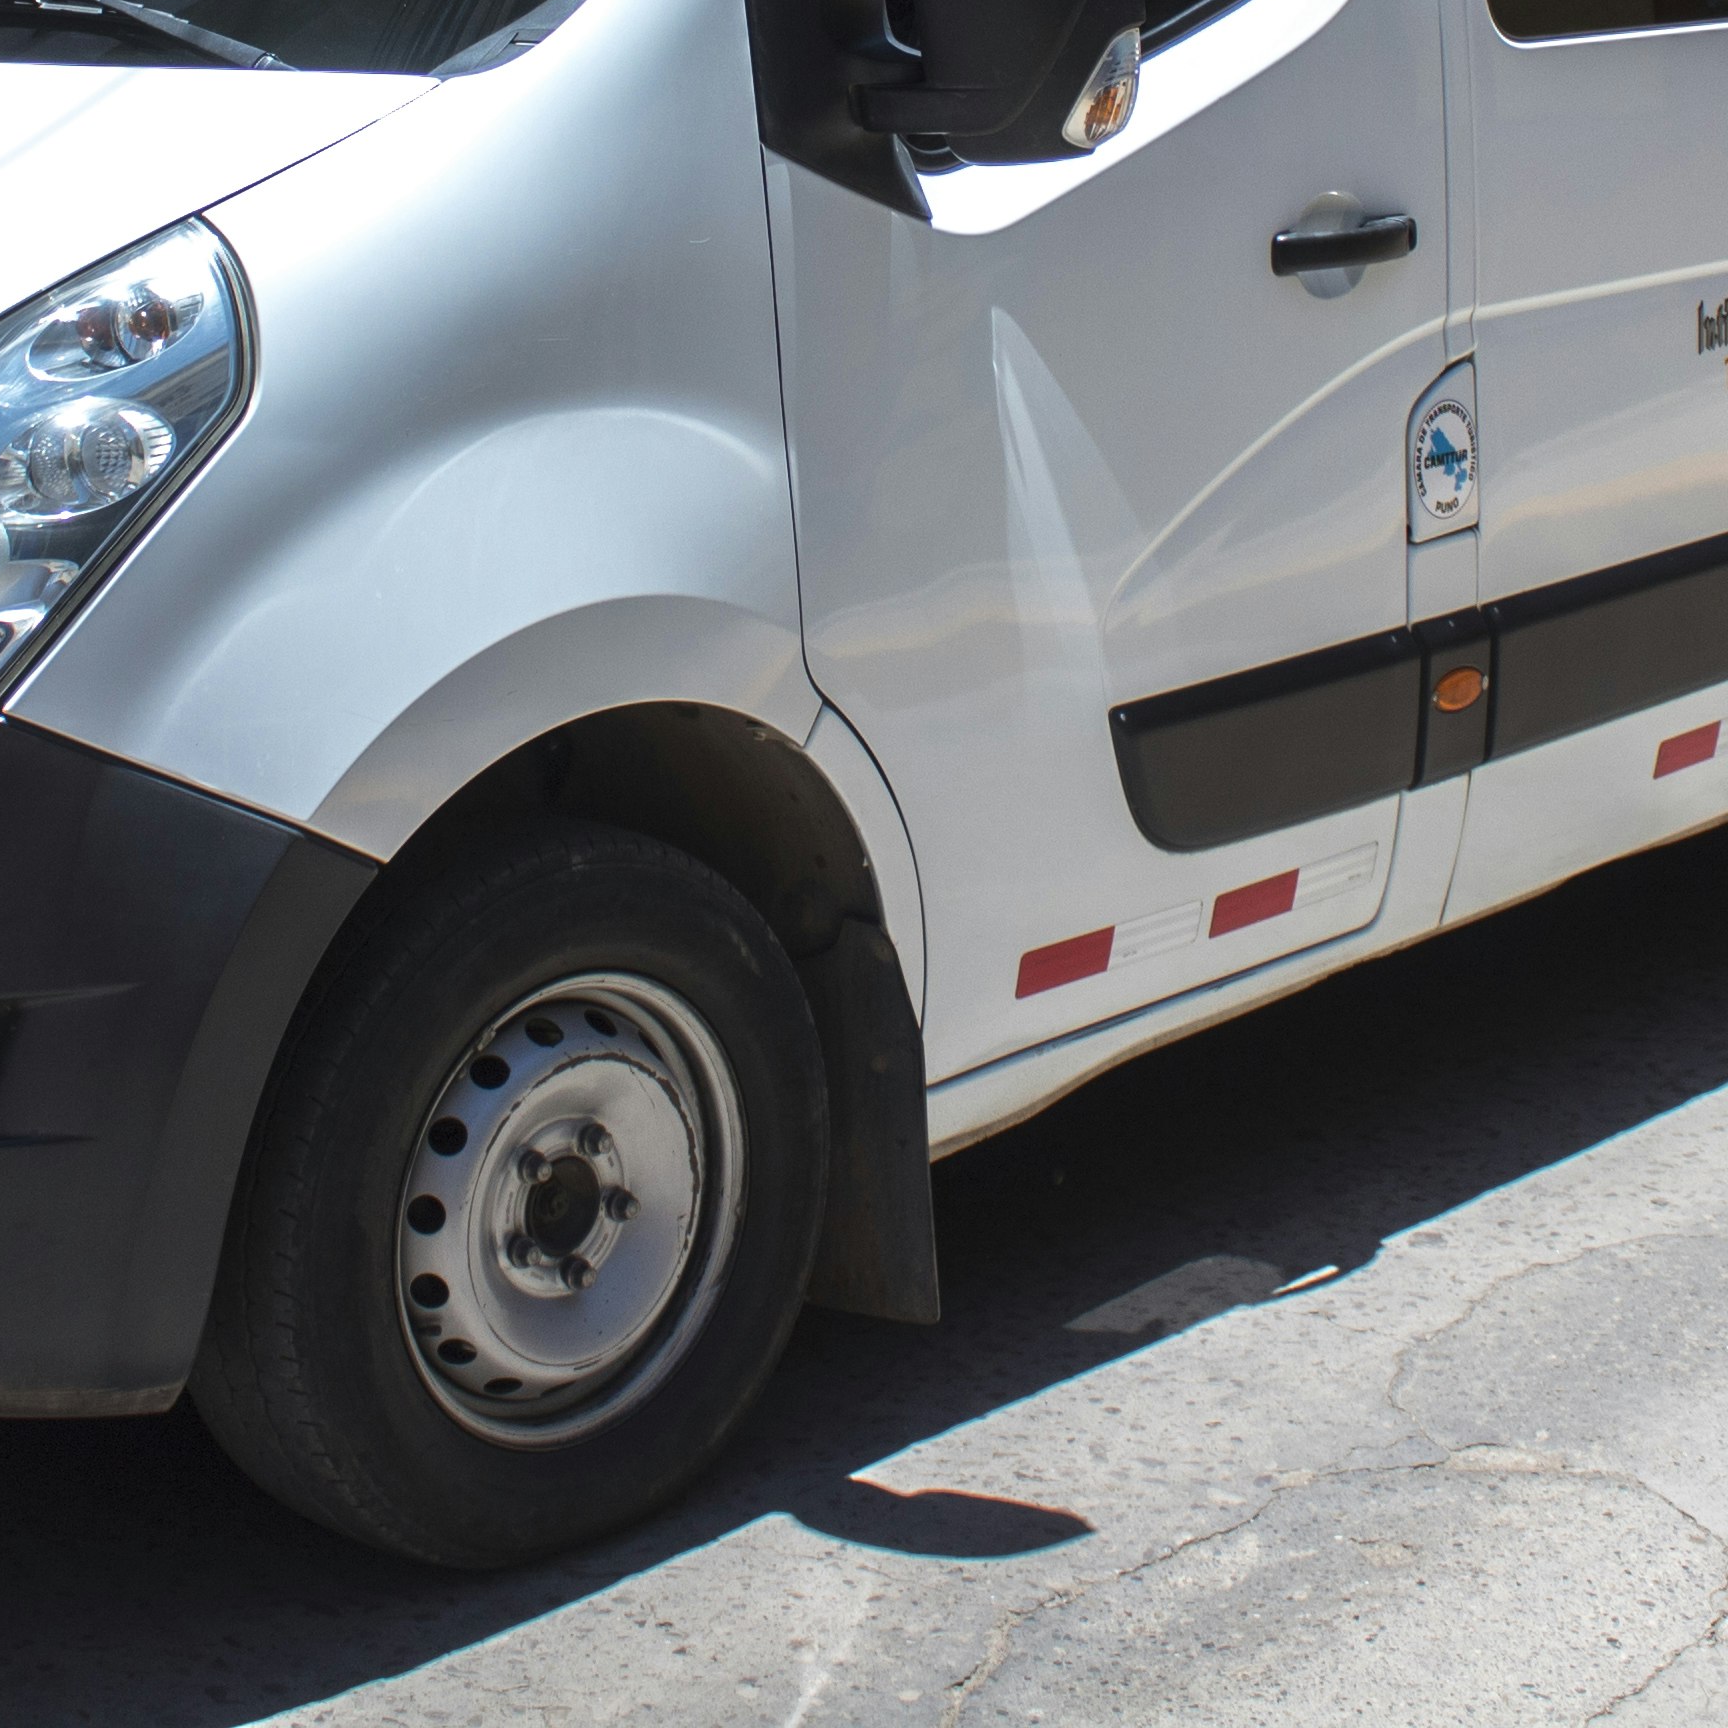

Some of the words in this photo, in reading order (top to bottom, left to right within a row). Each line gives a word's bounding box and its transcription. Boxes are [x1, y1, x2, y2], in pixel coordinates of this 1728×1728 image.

[1418, 428, 1428, 444] DE
[1424, 449, 1468, 470] CAMTTUR
[1435, 496, 1460, 514] PUNO
